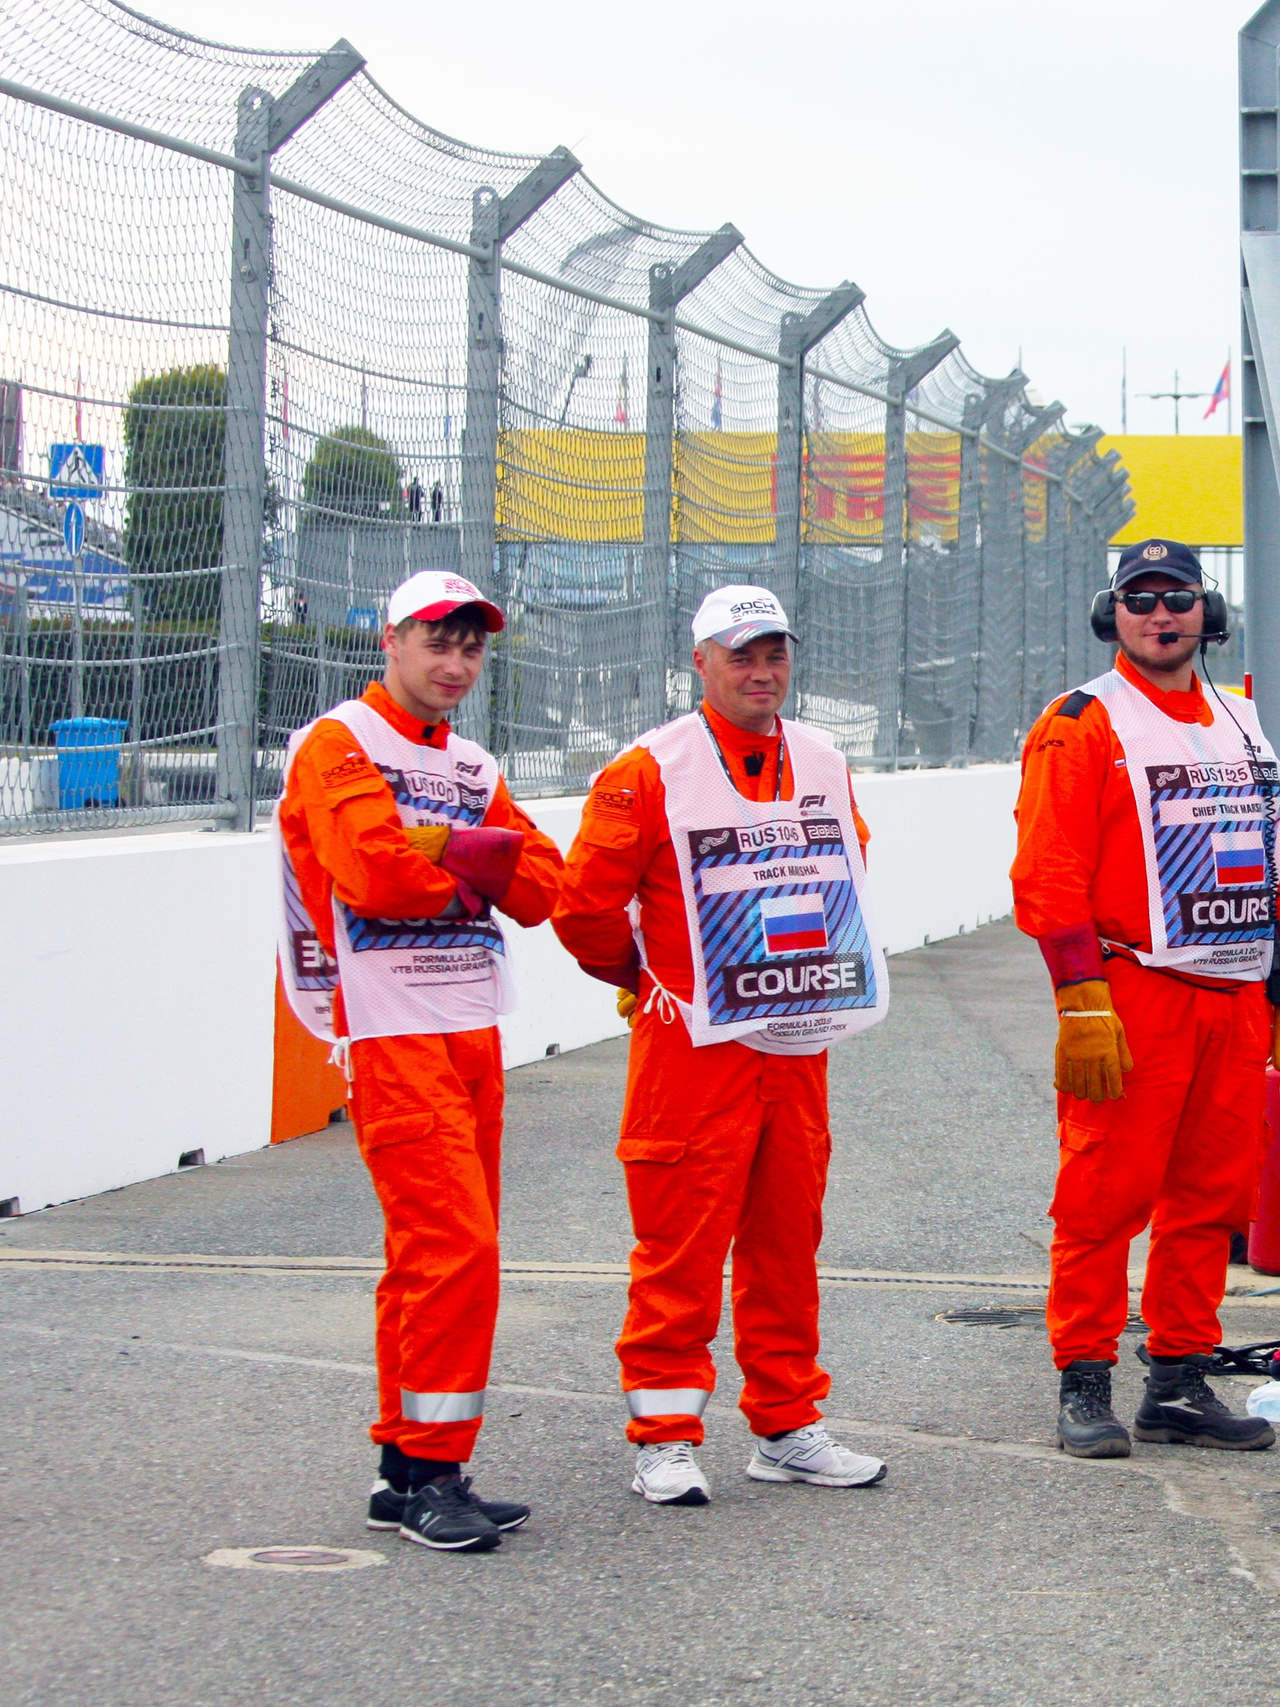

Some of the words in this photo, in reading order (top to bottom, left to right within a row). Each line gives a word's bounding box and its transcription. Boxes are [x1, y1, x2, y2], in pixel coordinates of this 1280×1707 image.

[1192, 805, 1217, 818] CHIEF
[806, 825, 841, 840] 2018
[753, 866, 786, 881] TRACK
[1192, 897, 1271, 925] COURS
[413, 955, 463, 964] FORMULA
[390, 966, 413, 974] VTB
[414, 964, 459, 974] RUSSIAN
[736, 962, 856, 998] COURSE
[767, 1022, 808, 1031] FORMULA
[830, 1024, 847, 1032] PRIX
